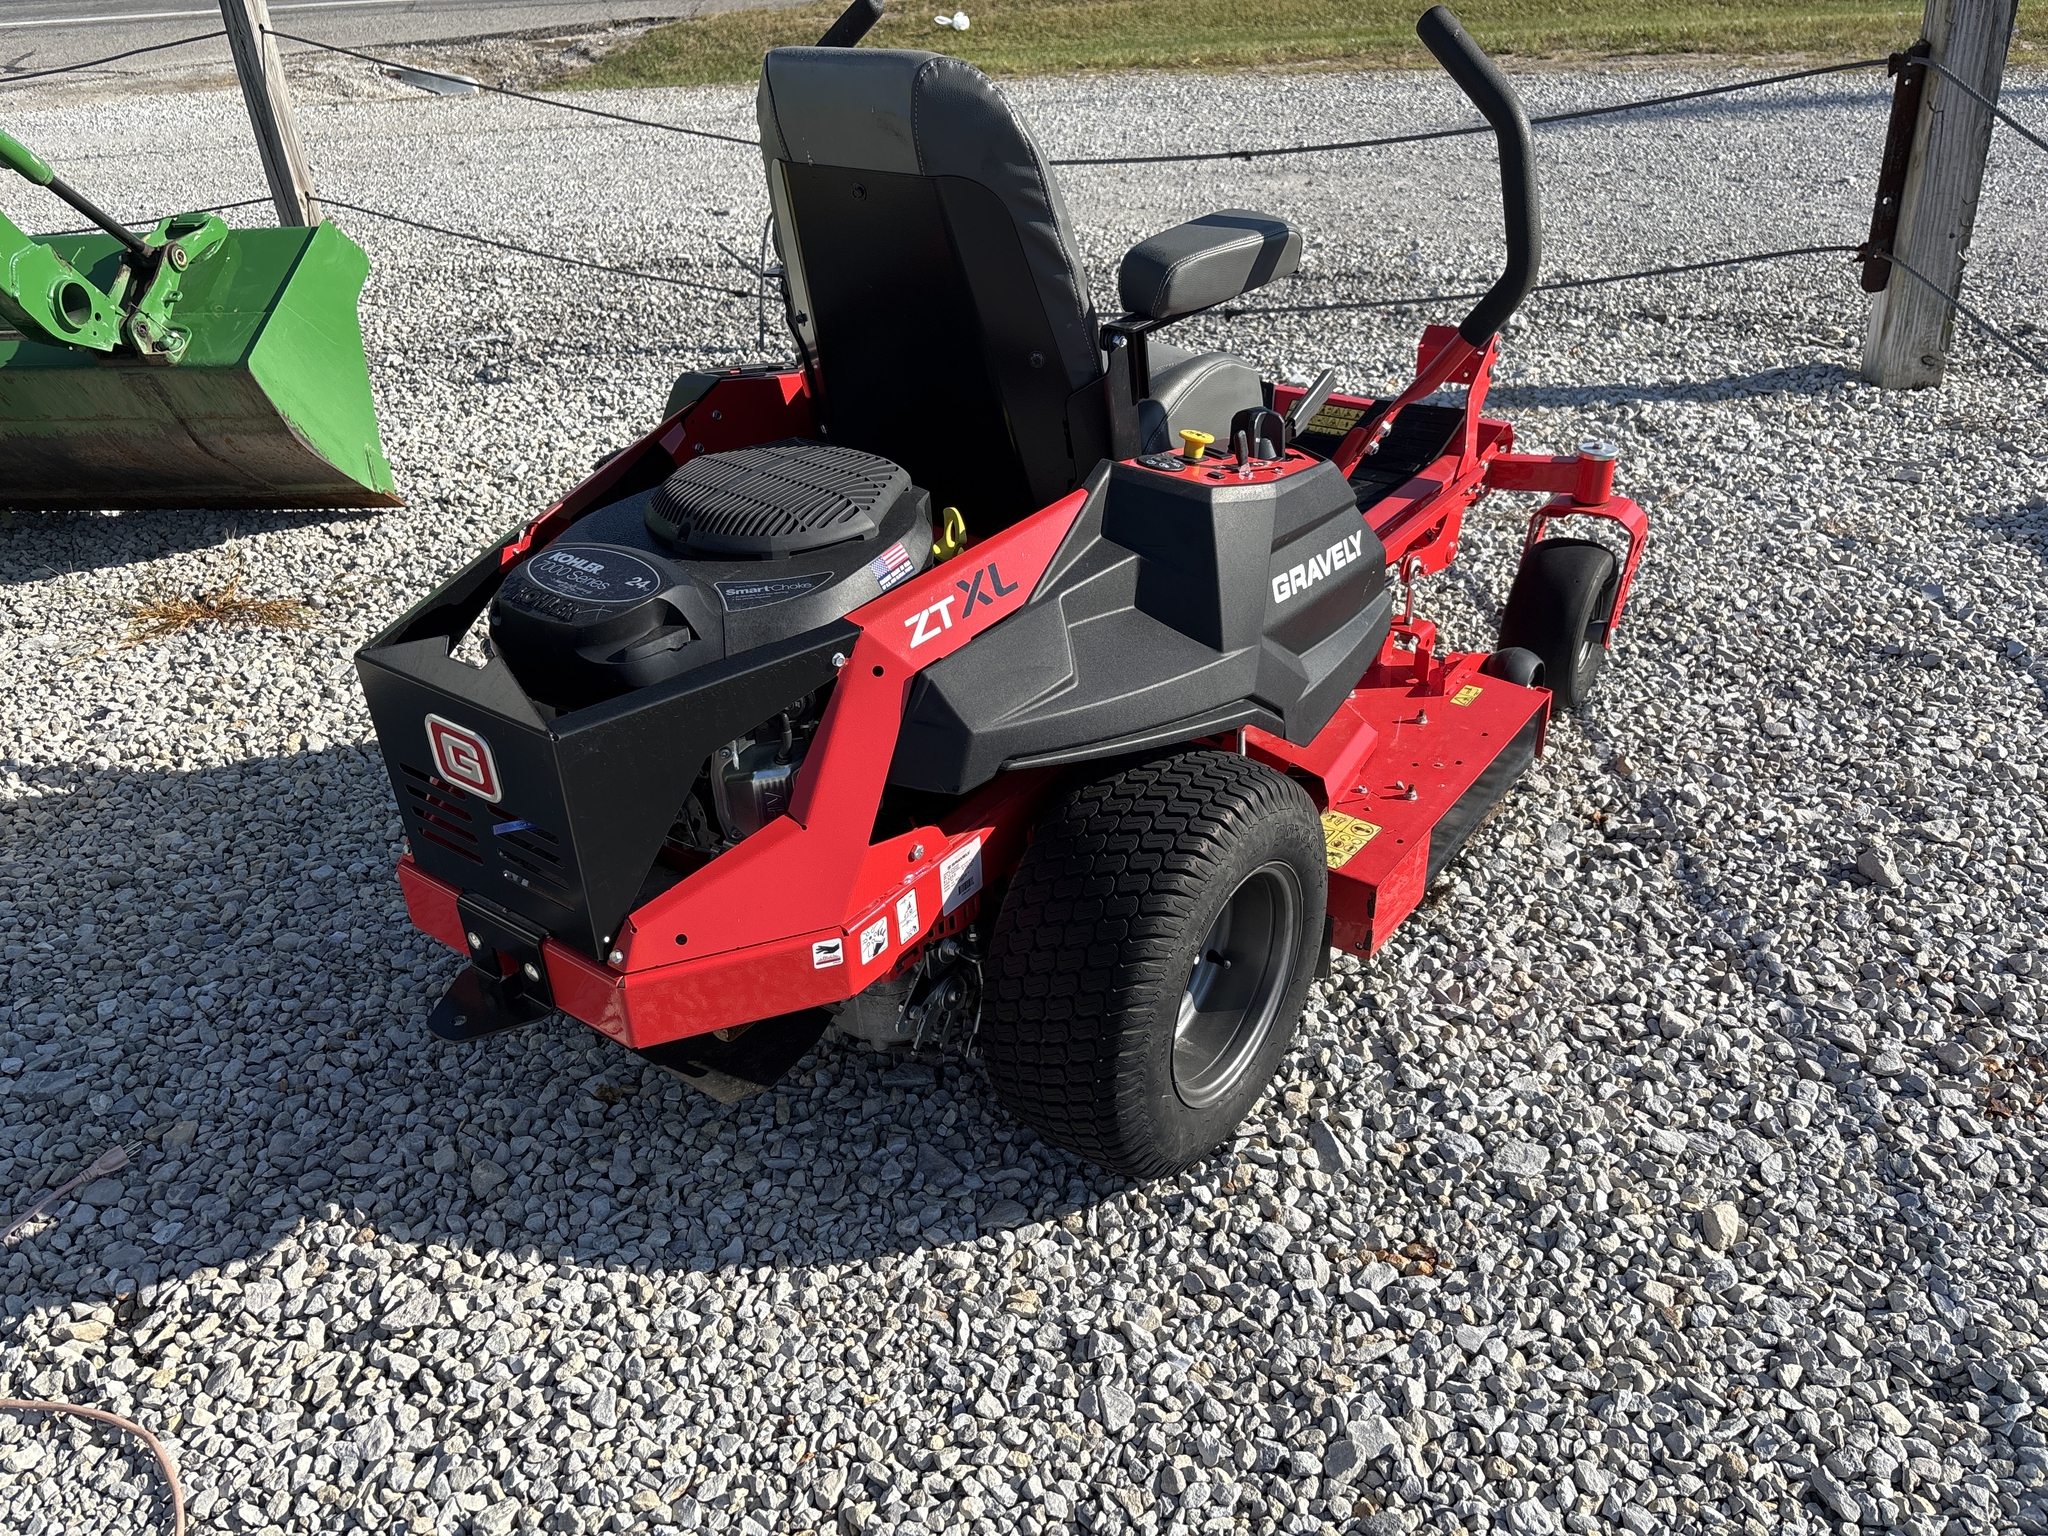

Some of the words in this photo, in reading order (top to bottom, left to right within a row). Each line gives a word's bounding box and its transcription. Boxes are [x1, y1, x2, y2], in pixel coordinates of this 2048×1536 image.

[533, 559, 573, 577] 7000
[566, 570, 611, 591] Series
[548, 551, 605, 575] KOHLER
[1272, 529, 1362, 604] GRAVELY
[624, 576, 652, 589] 24
[903, 594, 956, 650] ZT
[955, 562, 1019, 619] XL
